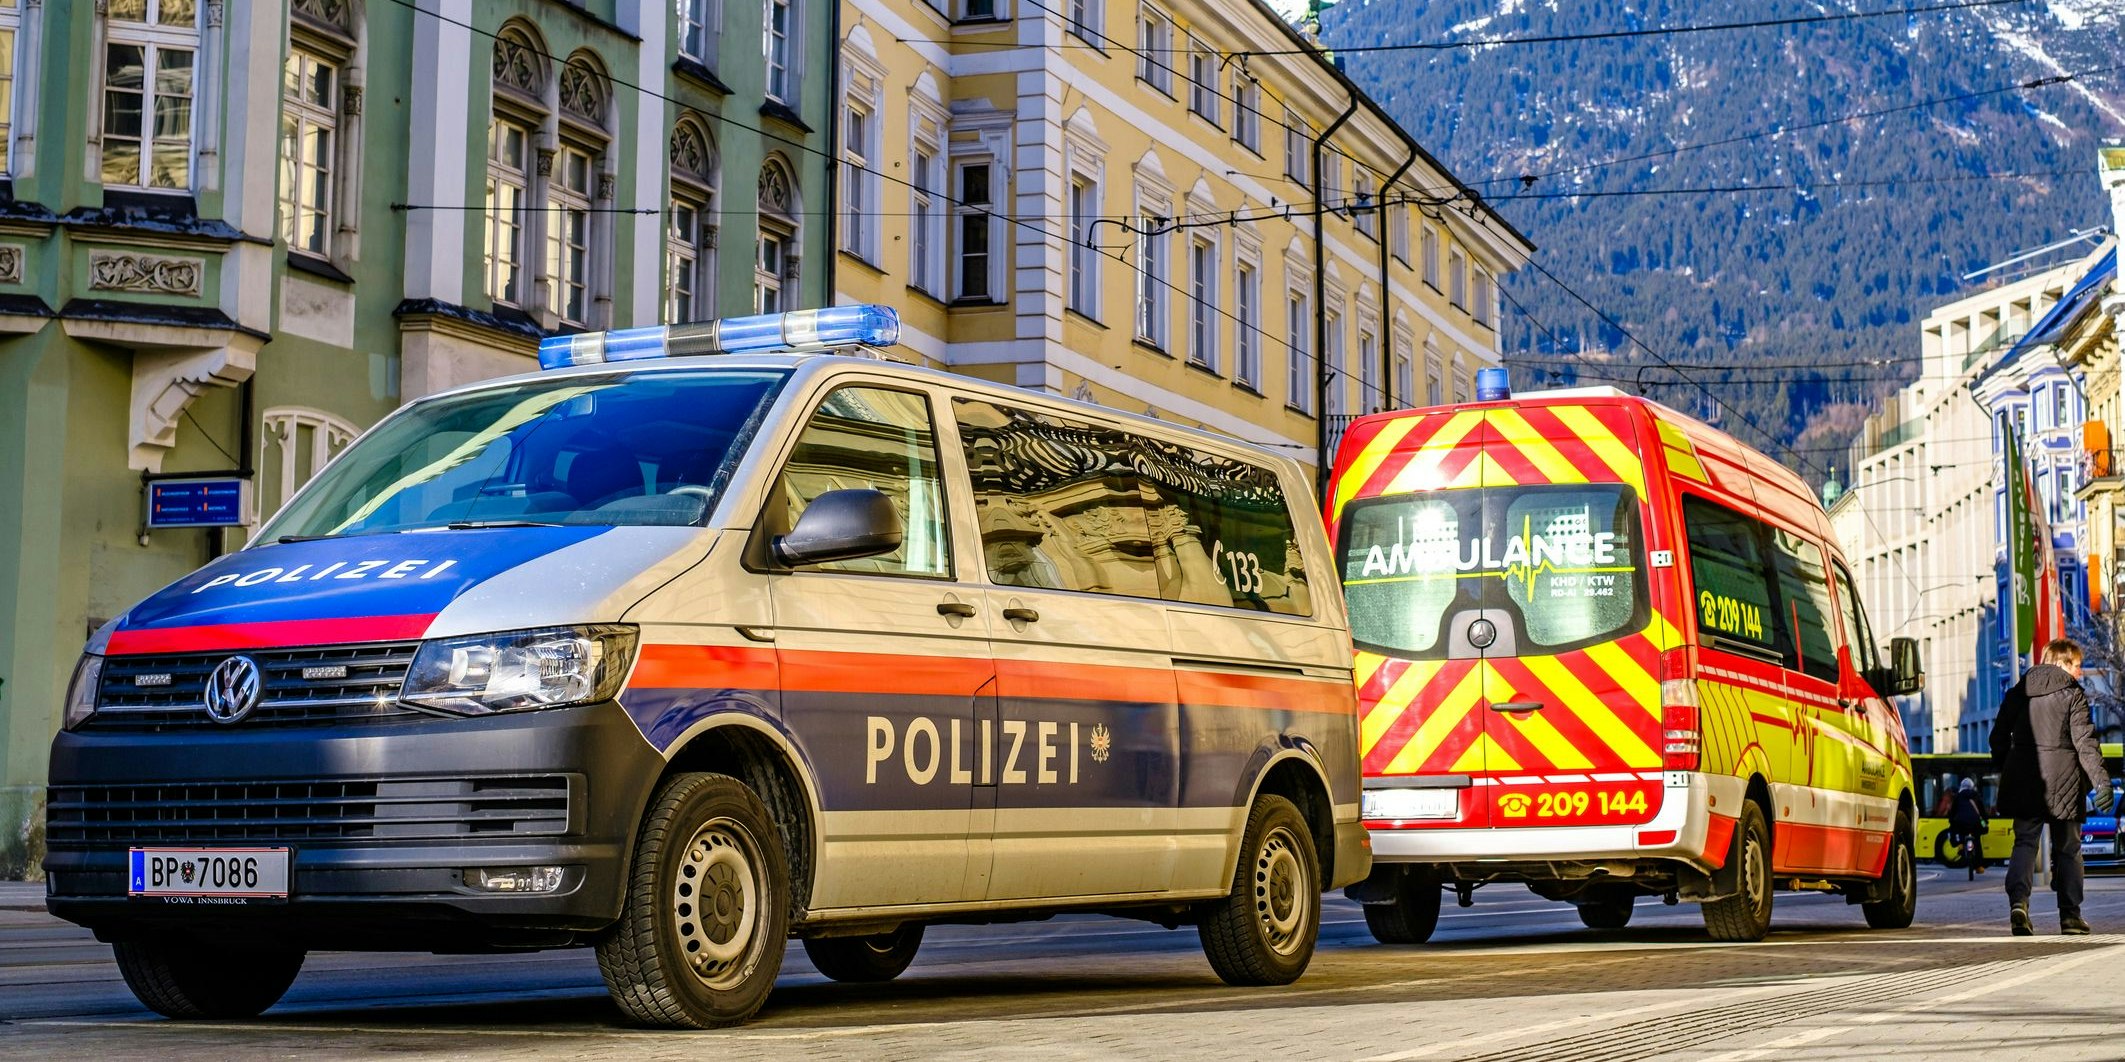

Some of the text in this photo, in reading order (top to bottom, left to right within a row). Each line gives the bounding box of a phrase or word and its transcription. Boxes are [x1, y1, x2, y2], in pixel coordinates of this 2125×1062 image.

[1361, 532, 1616, 577] AMULANCE
[191, 560, 458, 594] POLIZEI
[1226, 551, 1263, 594] 133
[1551, 576, 1577, 587] KHD
[1587, 575, 1615, 586] KTW
[1717, 595, 1763, 641] 209 144
[866, 716, 1079, 786] POLIZEI
[1537, 790, 1649, 818] 209 144
[135, 876, 143, 887] A
[152, 857, 258, 888] BP 7086
[163, 896, 248, 905] VOWA INNSBRUCK
